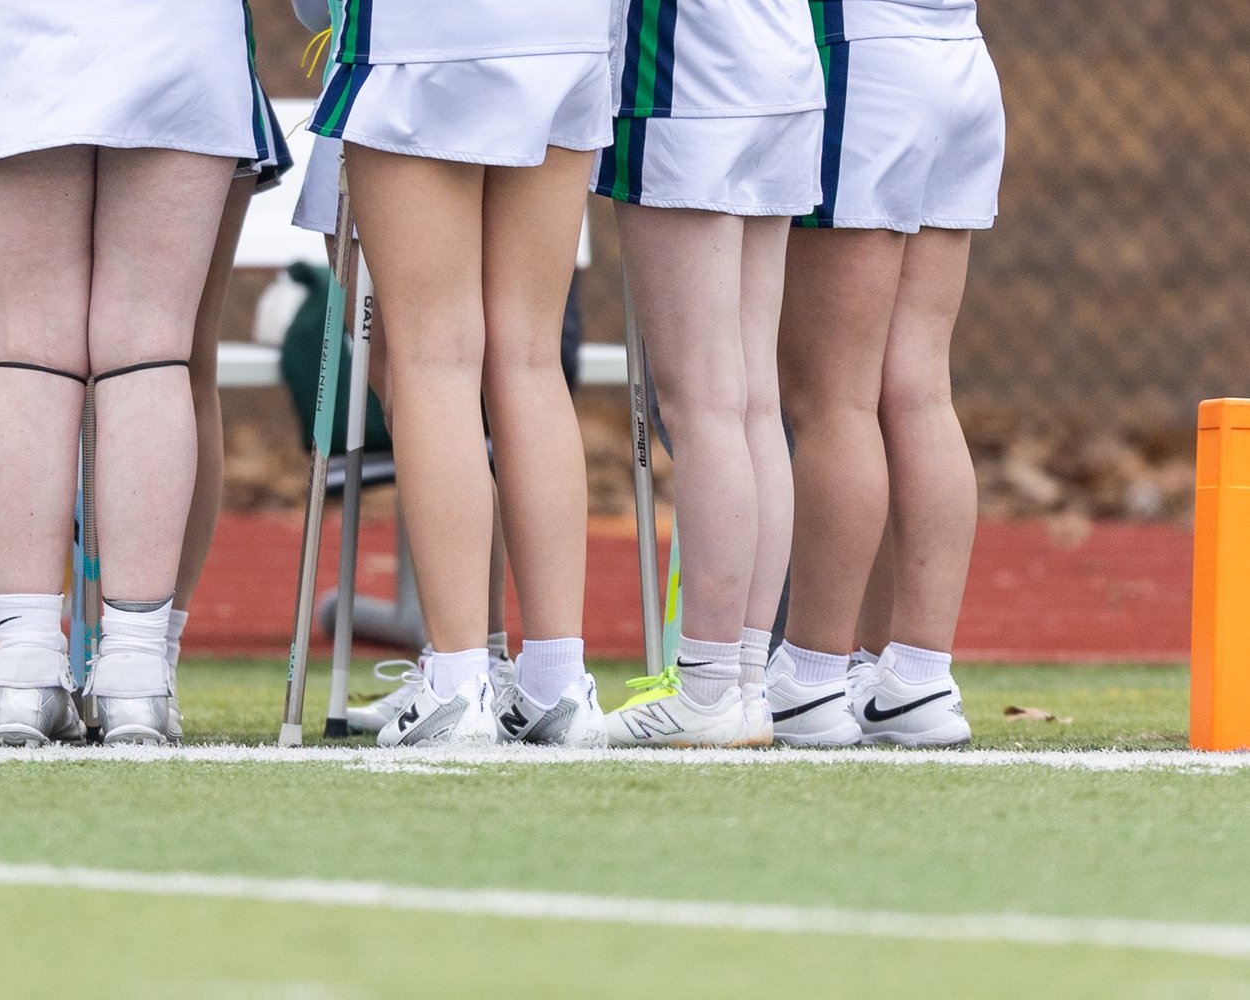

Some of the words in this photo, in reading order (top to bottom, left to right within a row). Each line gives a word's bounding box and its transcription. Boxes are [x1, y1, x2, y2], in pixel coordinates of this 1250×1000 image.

[361, 294, 374, 345] GAIT
[315, 338, 331, 413] MANTRA
[636, 415, 648, 468] deBeer
